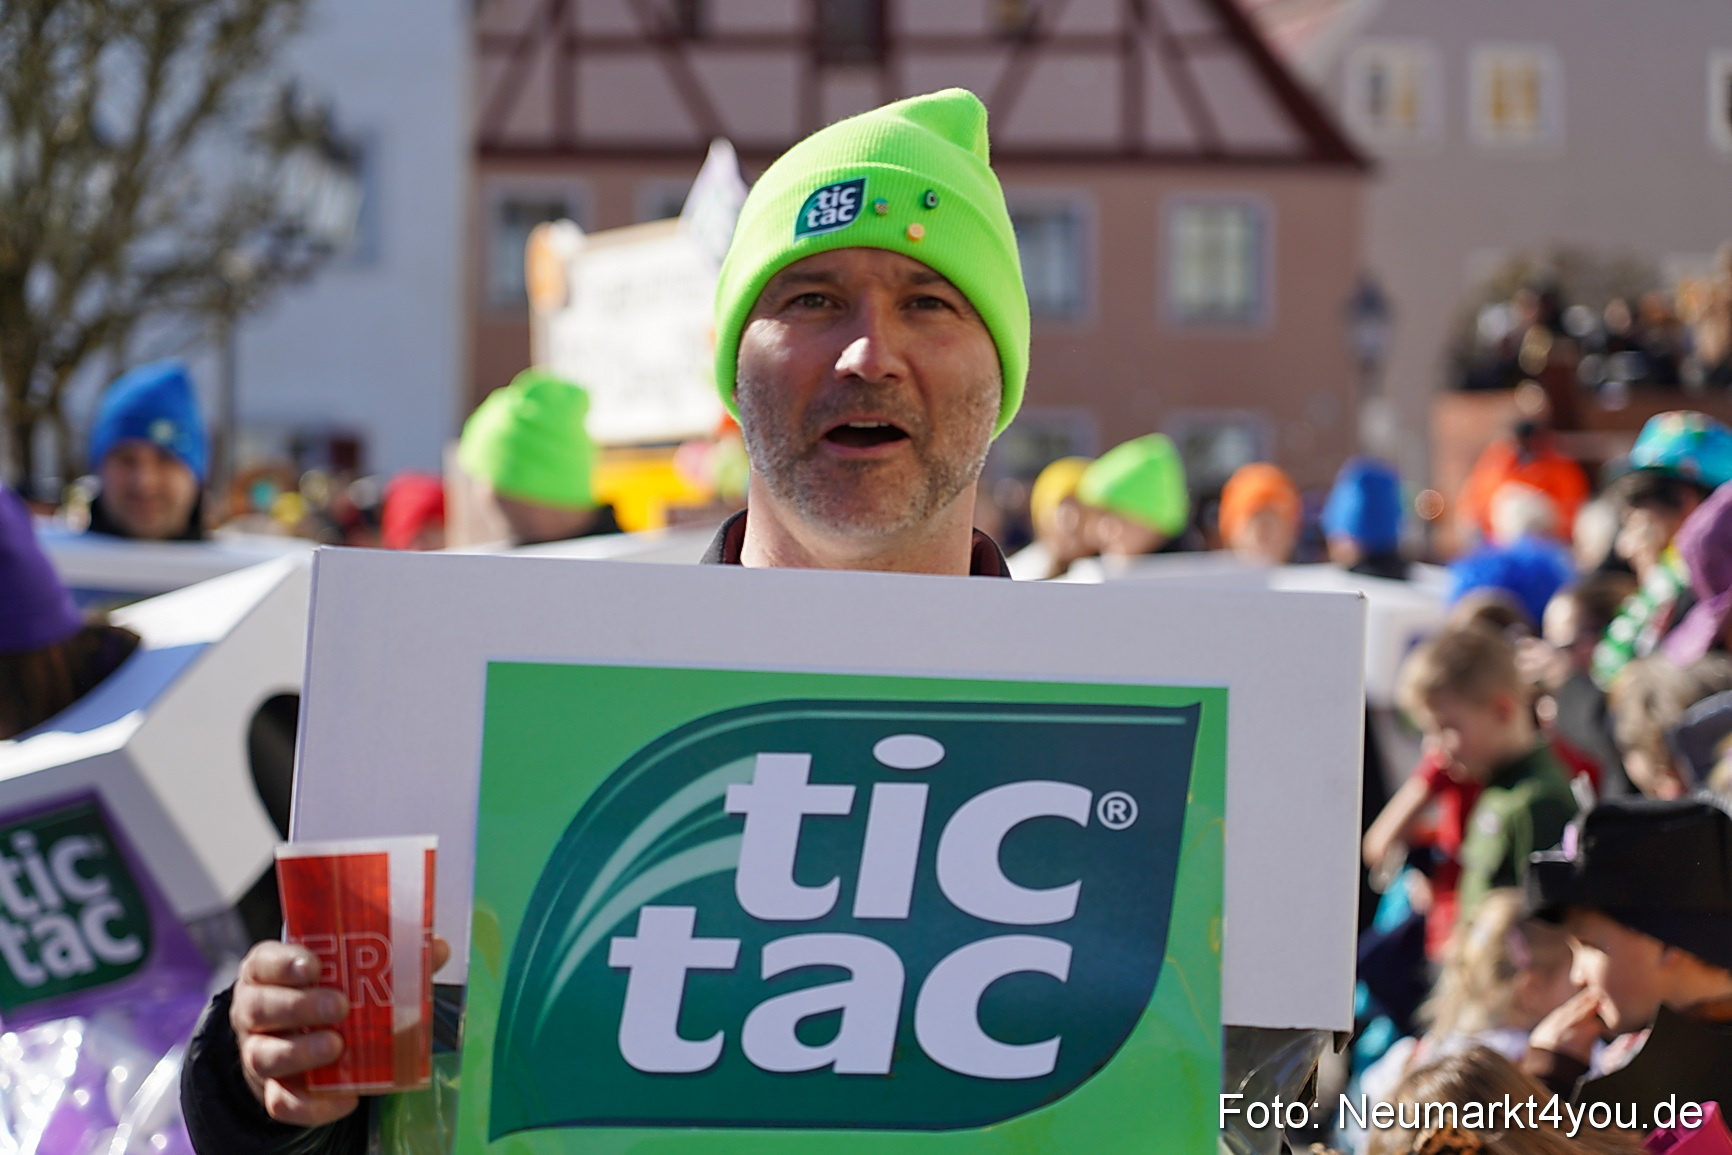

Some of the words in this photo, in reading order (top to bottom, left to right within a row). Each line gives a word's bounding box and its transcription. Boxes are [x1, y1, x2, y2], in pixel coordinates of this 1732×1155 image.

[817, 186, 857, 210] tic
[807, 204, 854, 228] tac
[607, 904, 1073, 1080] tac
